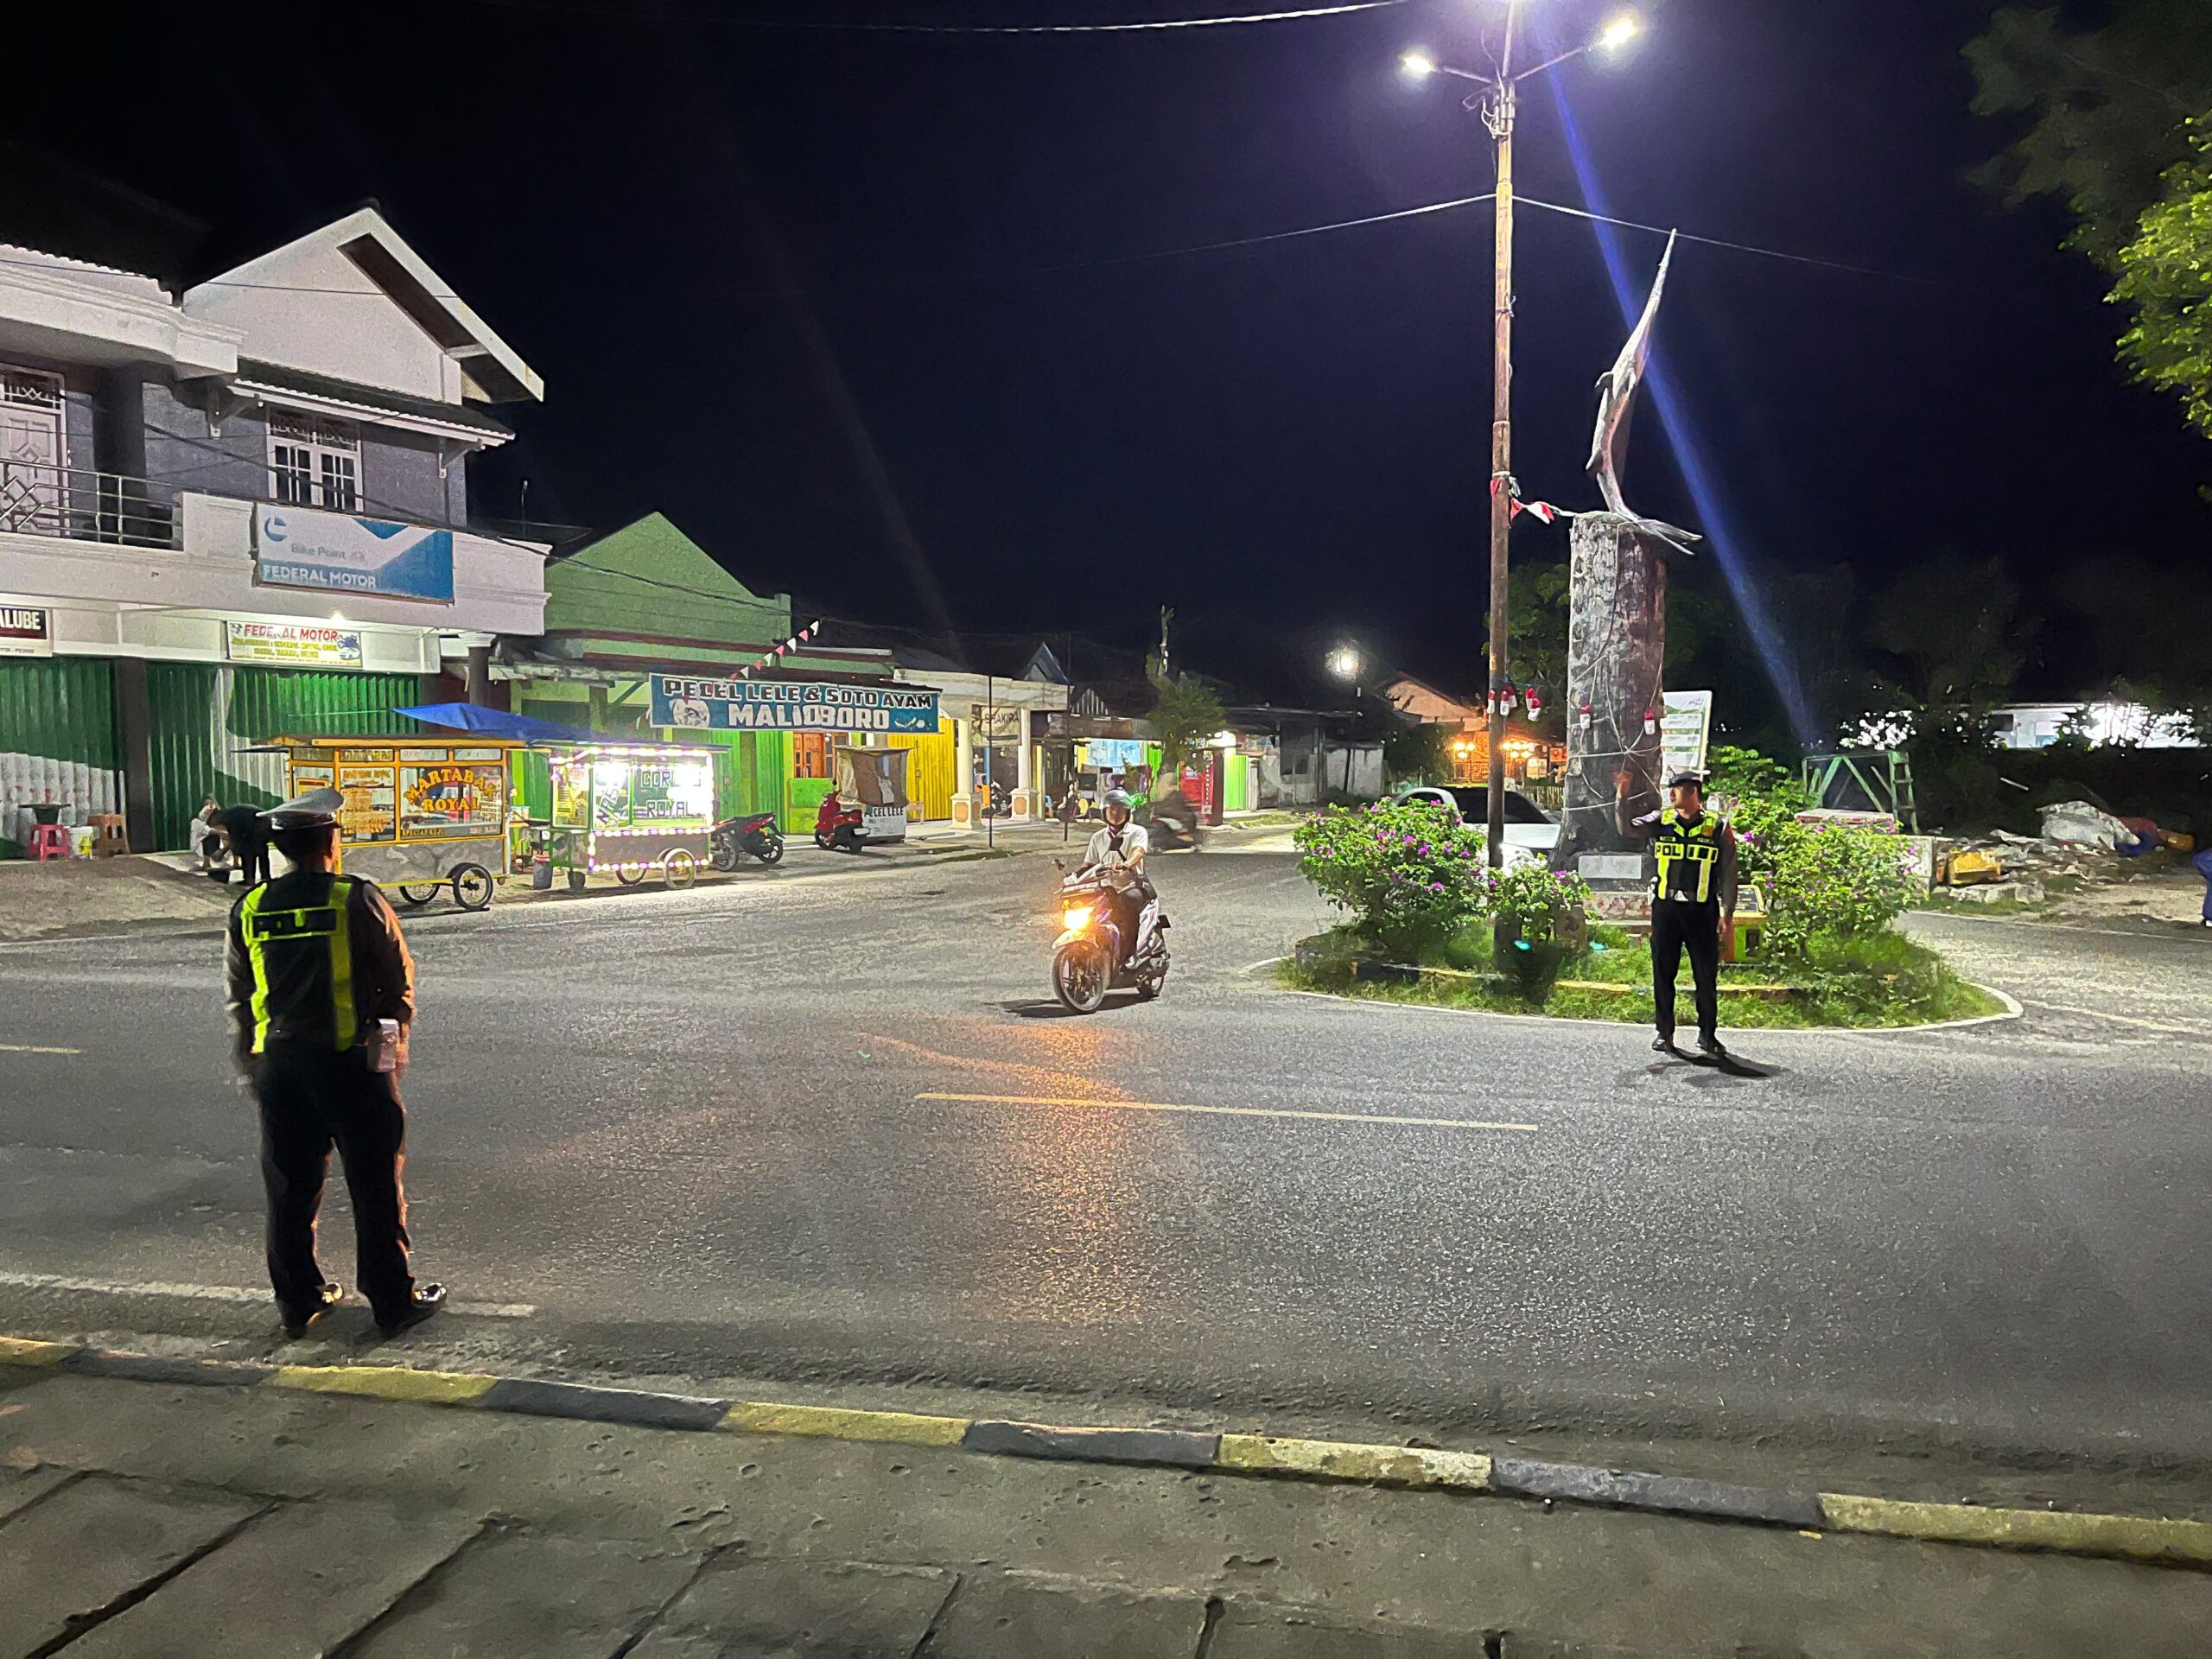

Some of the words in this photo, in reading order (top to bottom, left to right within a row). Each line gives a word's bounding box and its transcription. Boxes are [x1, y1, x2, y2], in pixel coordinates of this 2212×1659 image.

[291, 543, 315, 556] Bike
[318, 546, 346, 560] Point
[263, 564, 327, 582] FEDERAL
[329, 571, 377, 588] MOTOR
[300, 628, 339, 641] MOTOR
[663, 677, 742, 702] PECEL
[746, 684, 801, 702] LELE
[804, 685, 822, 702] &
[825, 687, 879, 707] SOTO
[881, 694, 932, 709] AYAM
[728, 703, 890, 729] MALIOBORO
[423, 797, 480, 812] ROYAL
[646, 801, 695, 817] ROYAL
